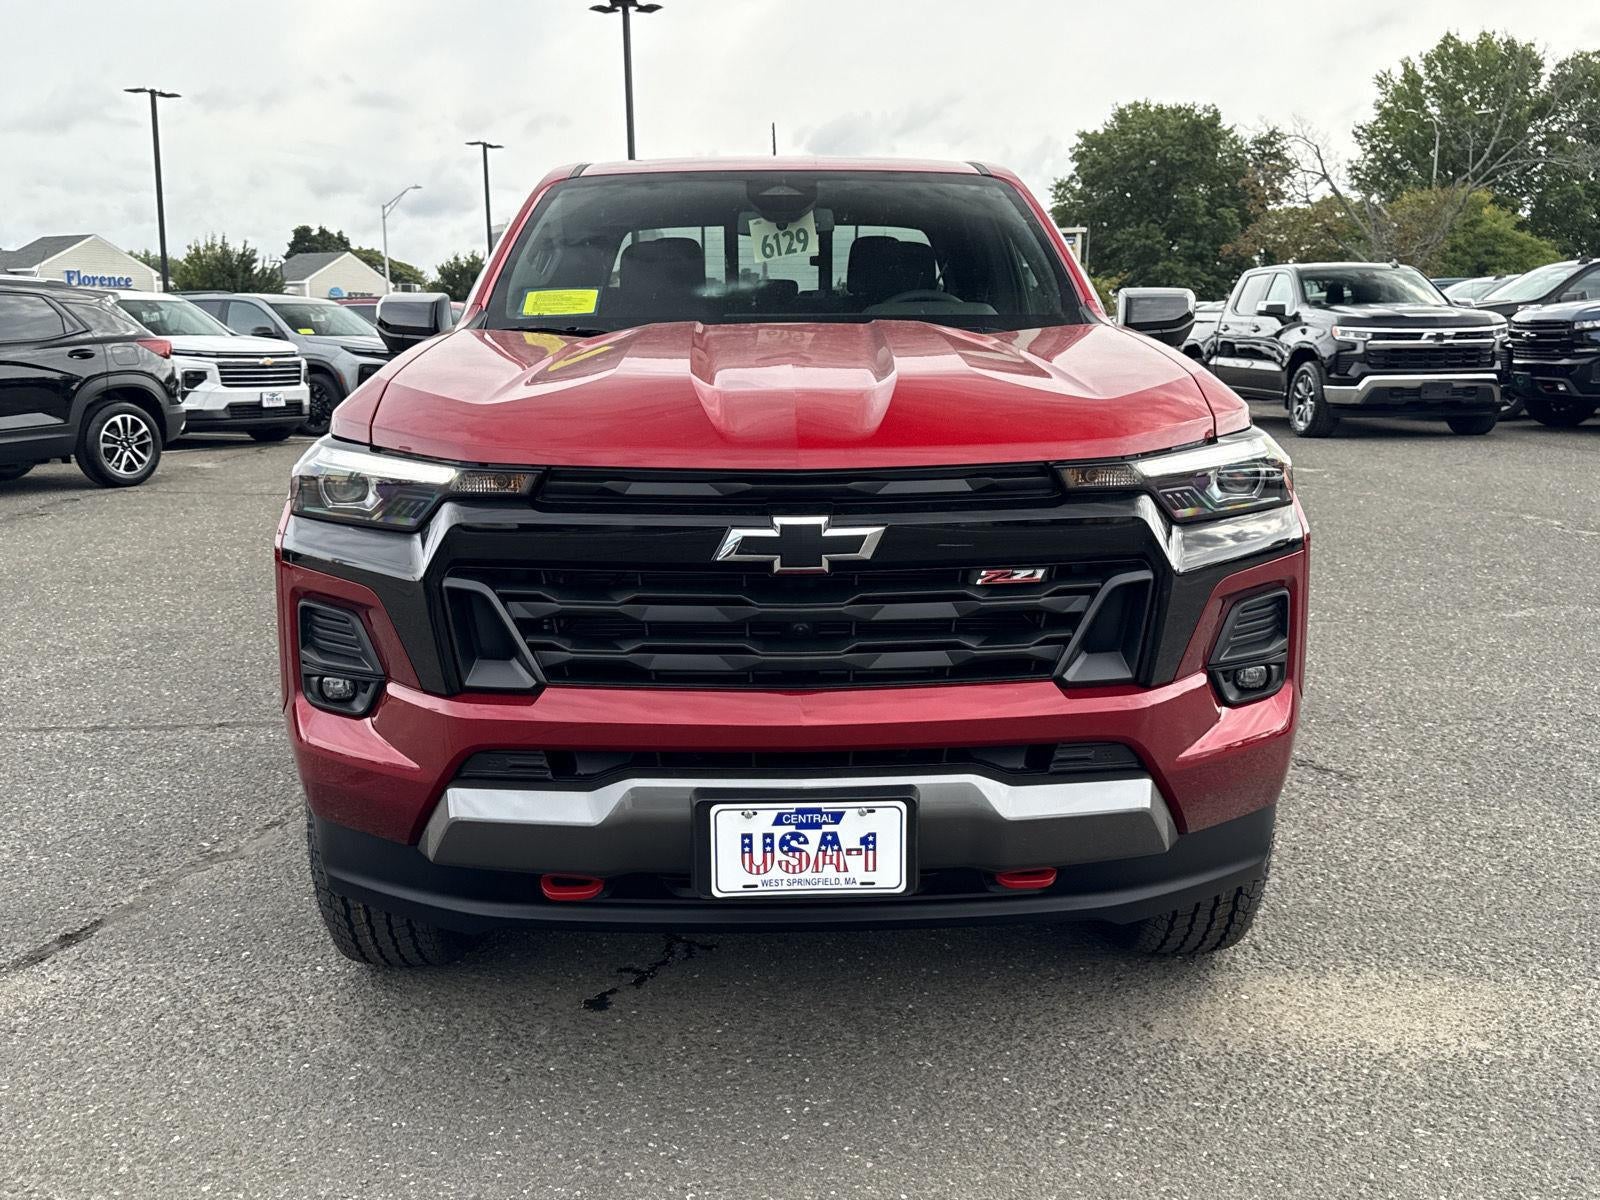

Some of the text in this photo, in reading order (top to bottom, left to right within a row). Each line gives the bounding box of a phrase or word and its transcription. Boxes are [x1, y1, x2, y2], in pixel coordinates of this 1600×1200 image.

[761, 227, 809, 259] 6129
[64, 269, 133, 288] Florence
[782, 813, 835, 824] CENTRAL
[740, 830, 877, 875] USA-1
[761, 877, 857, 888] WEST SPRINGFIELD, MA
